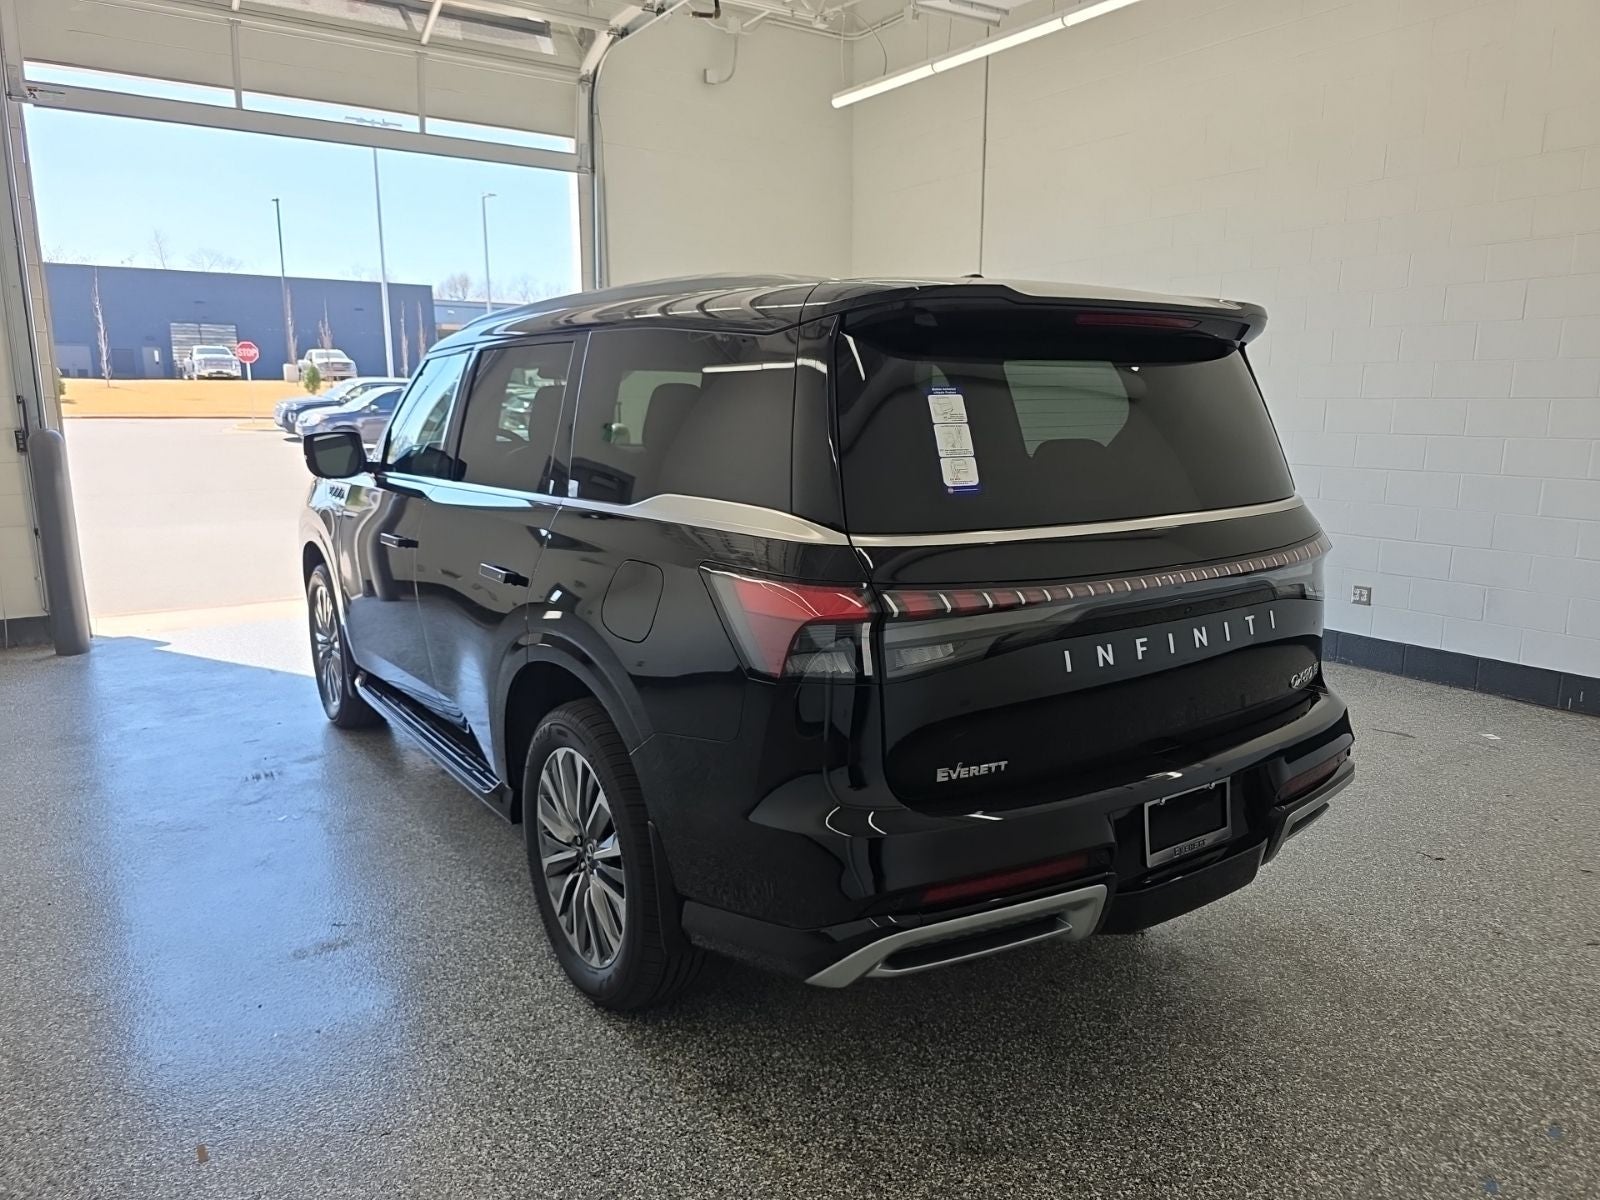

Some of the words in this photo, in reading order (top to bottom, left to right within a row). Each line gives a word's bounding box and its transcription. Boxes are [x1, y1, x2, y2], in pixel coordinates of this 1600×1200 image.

[238, 347, 258, 357] STOP
[1064, 610, 1276, 672] INFINITI
[936, 760, 1008, 782] EVERETT
